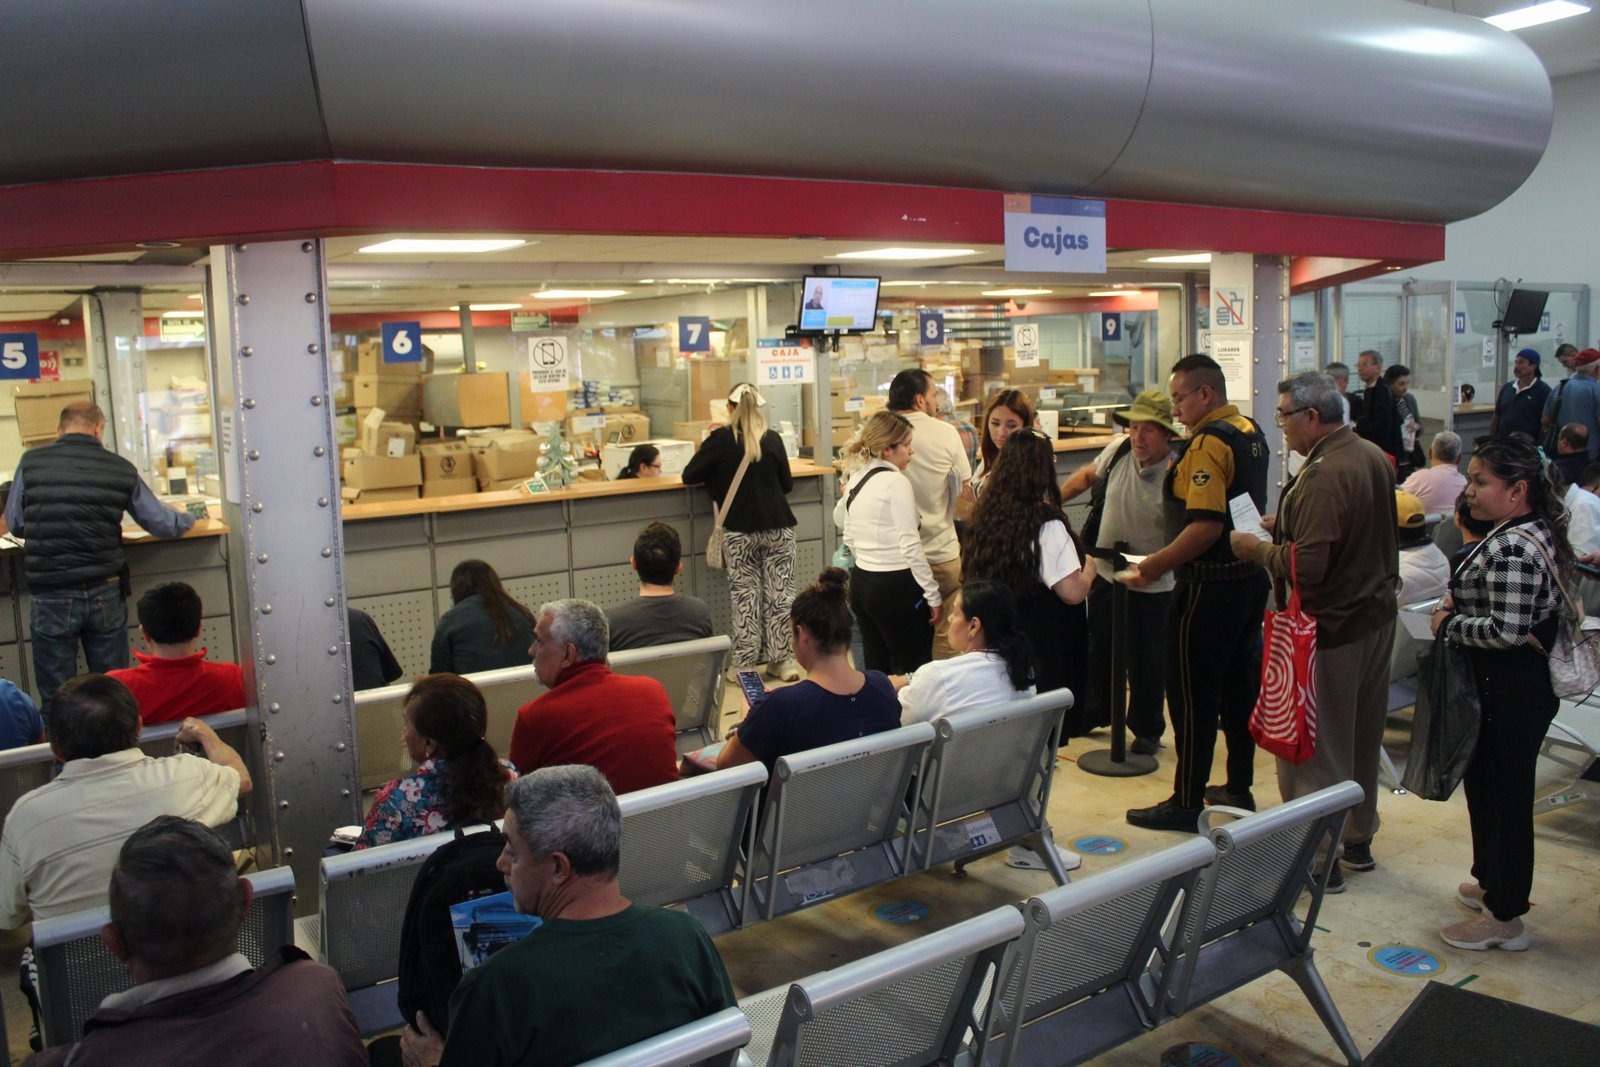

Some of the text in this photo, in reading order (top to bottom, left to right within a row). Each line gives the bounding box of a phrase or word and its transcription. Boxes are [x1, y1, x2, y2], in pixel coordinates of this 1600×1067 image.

[1023, 225, 1089, 256] Cajas
[687, 323, 702, 344] 7
[925, 320, 938, 339] 8
[1106, 319, 1116, 335] 9
[392, 330, 413, 355] 6
[771, 348, 799, 357] CAJA
[2, 342, 27, 369] 5
[1252, 443, 1262, 457] 61
